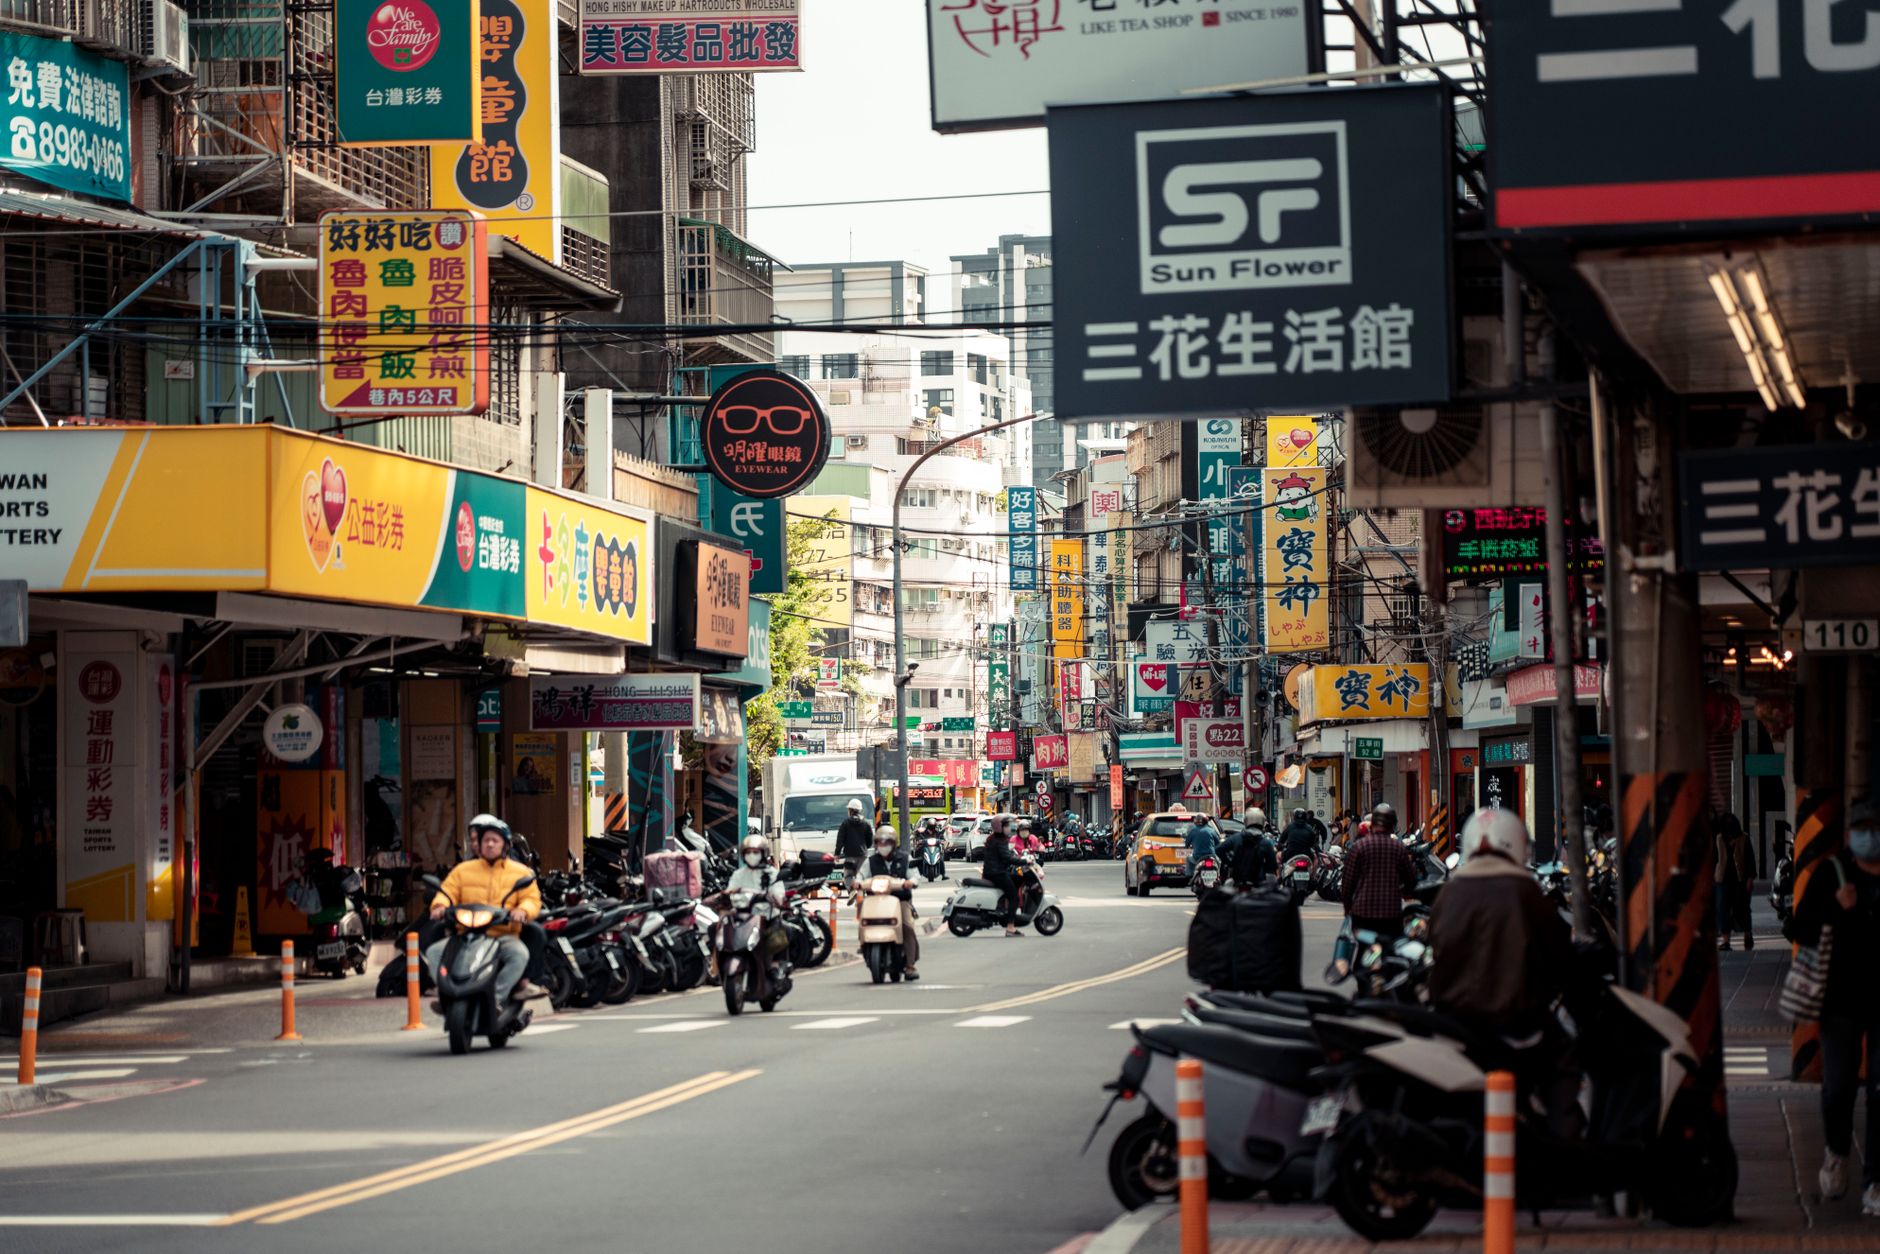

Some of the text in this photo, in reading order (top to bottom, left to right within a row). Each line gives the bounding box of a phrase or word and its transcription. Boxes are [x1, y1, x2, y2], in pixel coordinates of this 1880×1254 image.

[391, 7, 415, 23] We
[400, 18, 423, 32] are
[1081, 21, 1117, 36] LIKE
[1119, 20, 1151, 33] TEA
[1153, 15, 1195, 31] SHOP
[1226, 9, 1268, 24] SINCE
[367, 20, 441, 55] Family
[584, 22, 797, 65] 美容髮品批發
[8, 56, 121, 132] 免費法律諮詢
[366, 87, 443, 107] 台灣彩券
[1159, 158, 1323, 248] SF
[329, 218, 432, 252] 好好吃
[1150, 258, 1343, 285] Sun Flower
[1083, 305, 1414, 382] 三花生活館
[735, 465, 789, 475] EYEWEAR
[0, 501, 49, 518] RTS
[347, 497, 404, 552] 公益彩券
[0, 528, 63, 545] TERY
[478, 531, 520, 574] 台灣彩券
[1011, 490, 1033, 588] 好客多蔬果
[1276, 527, 1321, 619] 寶神
[1815, 622, 1868, 647] 110
[604, 686, 637, 697] HONG
[1334, 668, 1420, 713] 寶神
[86, 709, 115, 823] 運動彩券
